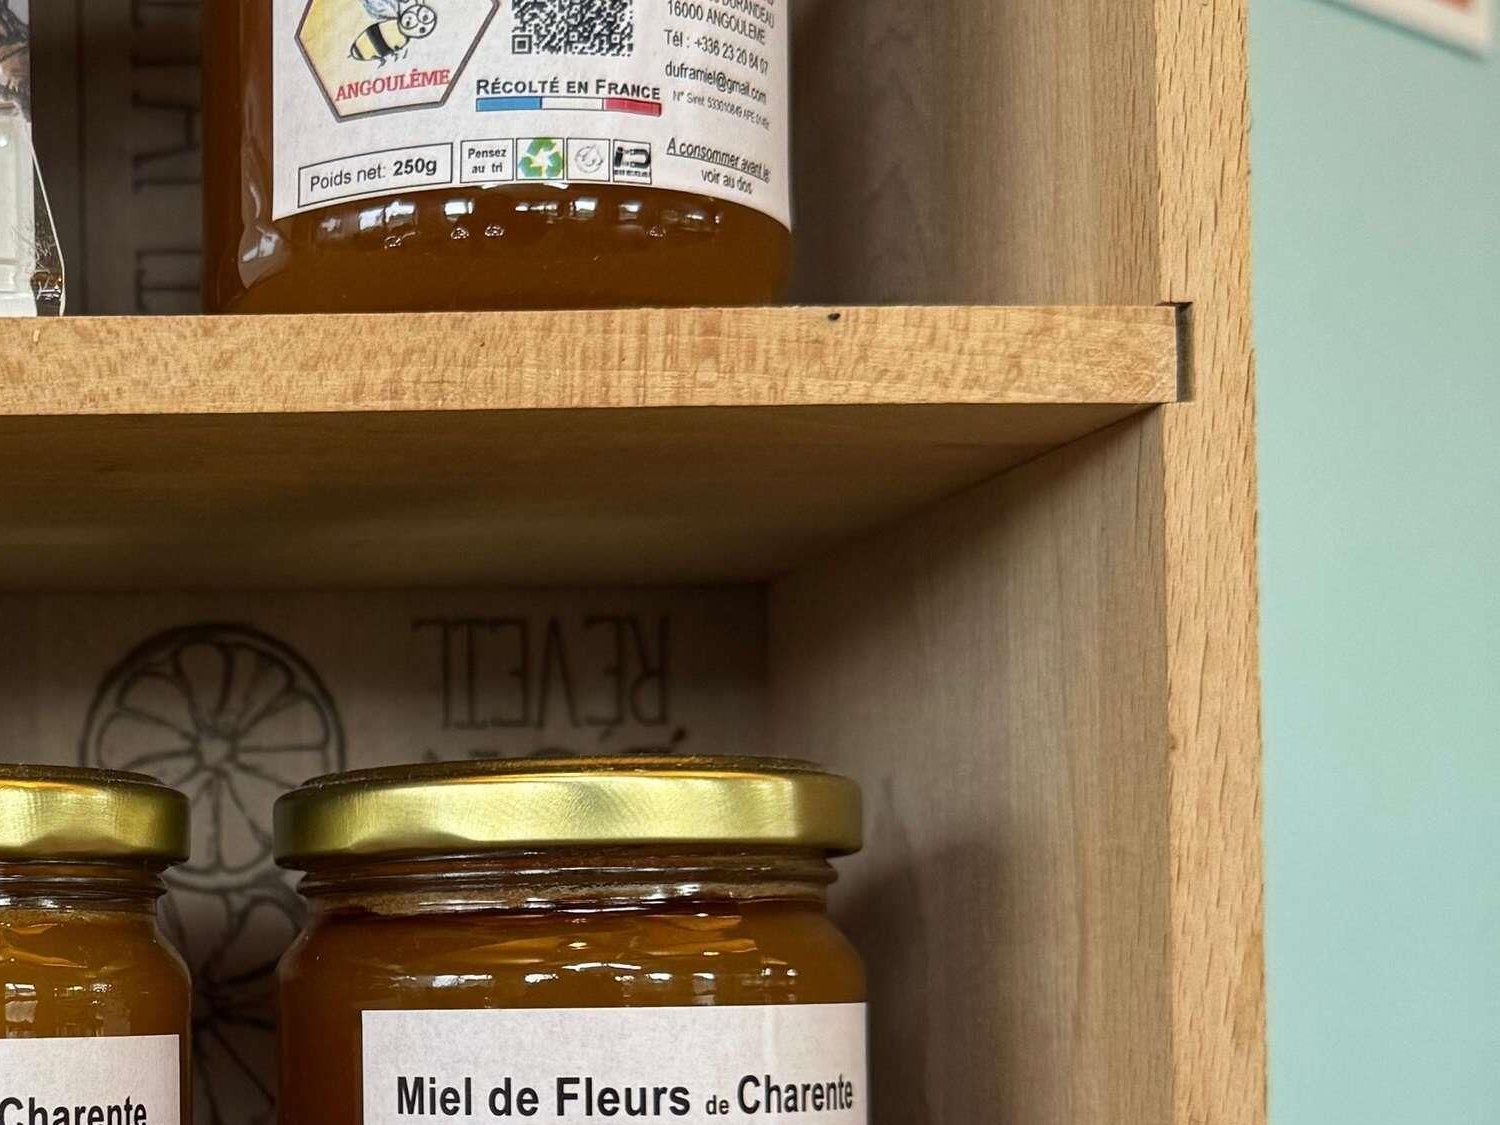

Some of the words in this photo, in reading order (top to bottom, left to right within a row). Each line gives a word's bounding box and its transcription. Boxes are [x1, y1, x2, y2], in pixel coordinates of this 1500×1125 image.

[336, 69, 450, 101] ANGOULÊME
[468, 148, 506, 159] Pensez
[310, 171, 351, 191] Poids
[356, 165, 386, 185] net:
[393, 158, 437, 178] 250g
[472, 165, 485, 174] au
[491, 162, 503, 173] tri
[701, 169, 720, 184] voir
[397, 1076, 472, 1116] Miel
[488, 1077, 539, 1116] de
[556, 1077, 690, 1116] Fleurs
[706, 1095, 730, 1115] de
[737, 1073, 853, 1114] Charente
